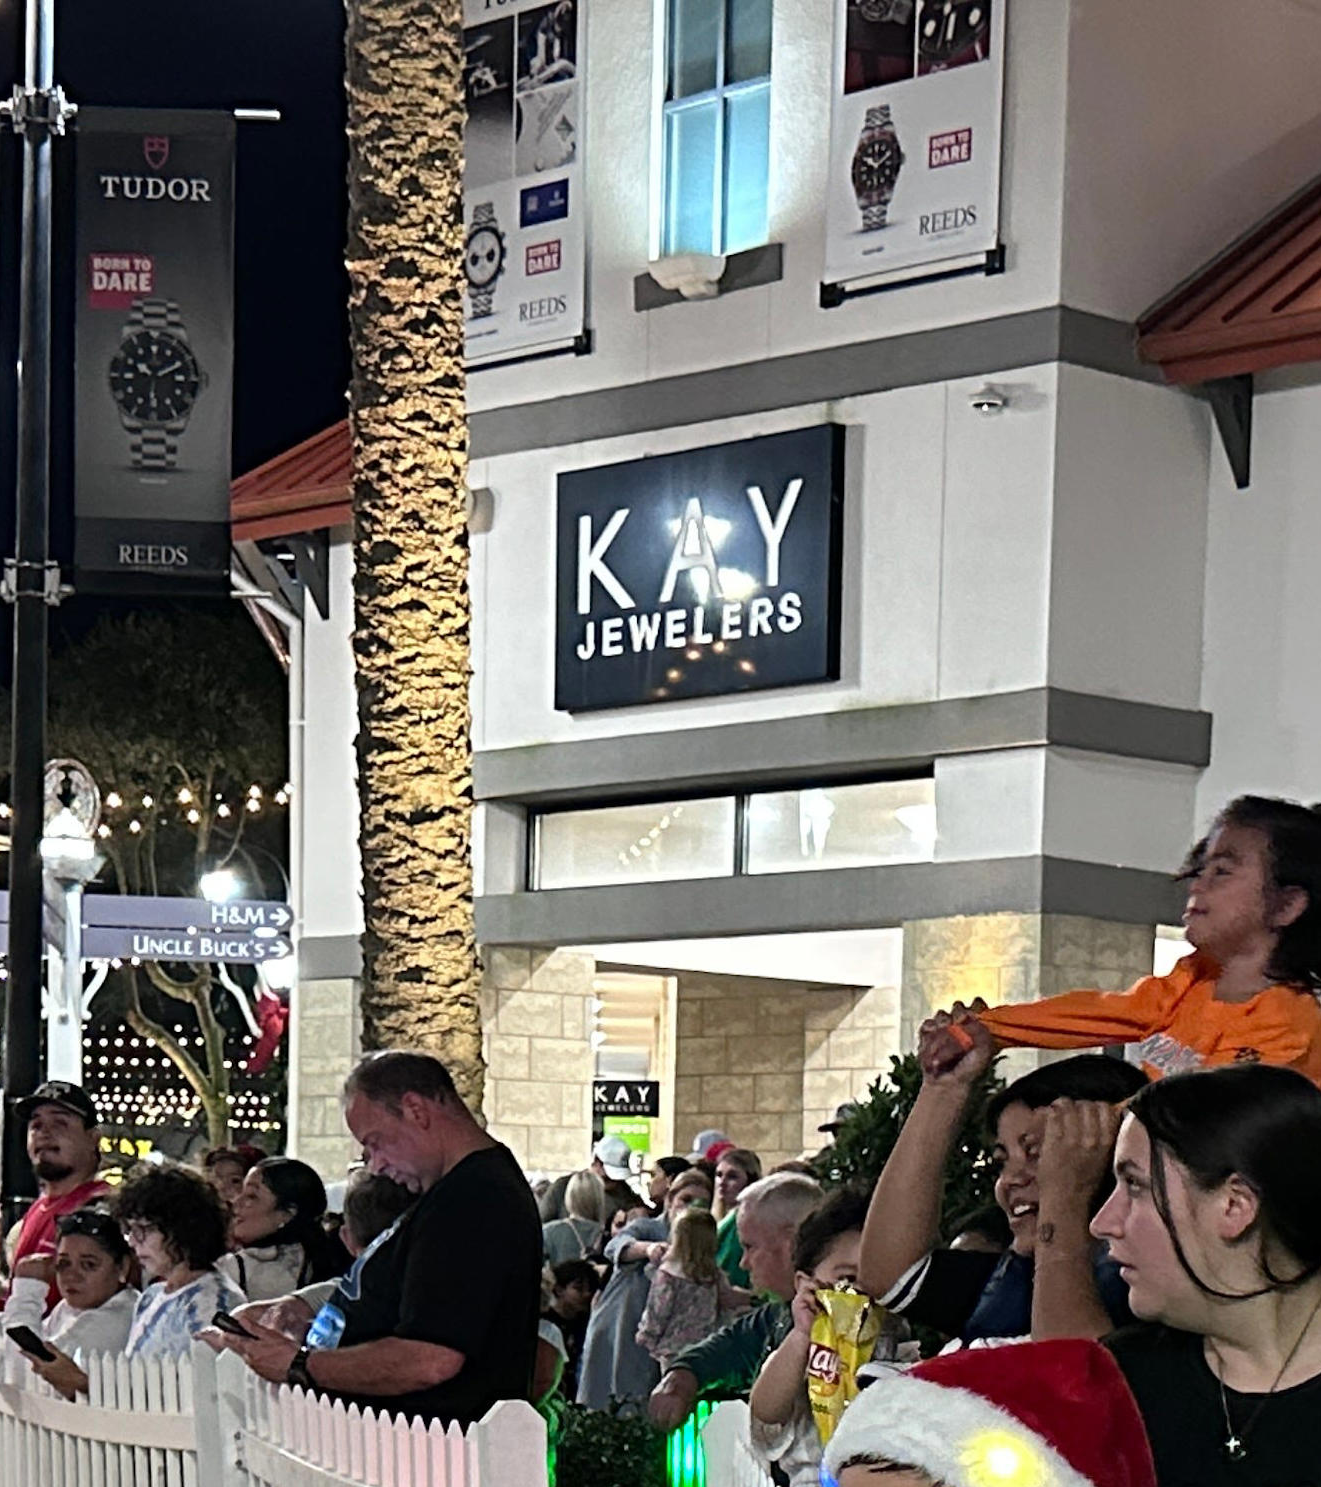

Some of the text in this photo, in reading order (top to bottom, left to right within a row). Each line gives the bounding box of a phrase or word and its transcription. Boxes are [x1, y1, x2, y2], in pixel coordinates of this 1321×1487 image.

[931, 142, 969, 166] DARE
[99, 175, 212, 202] TUDOR
[919, 204, 977, 236] REEDS
[93, 257, 152, 271] BORN TO
[93, 271, 152, 292] DARE
[518, 294, 567, 322] REEDS
[118, 544, 189, 567] REEDS
[577, 478, 803, 615] KAY
[577, 591, 803, 661] JEWELERS
[211, 904, 266, 926] H&M
[133, 935, 265, 958] UNCLE BUCK'S
[594, 1085, 650, 1104] KAY
